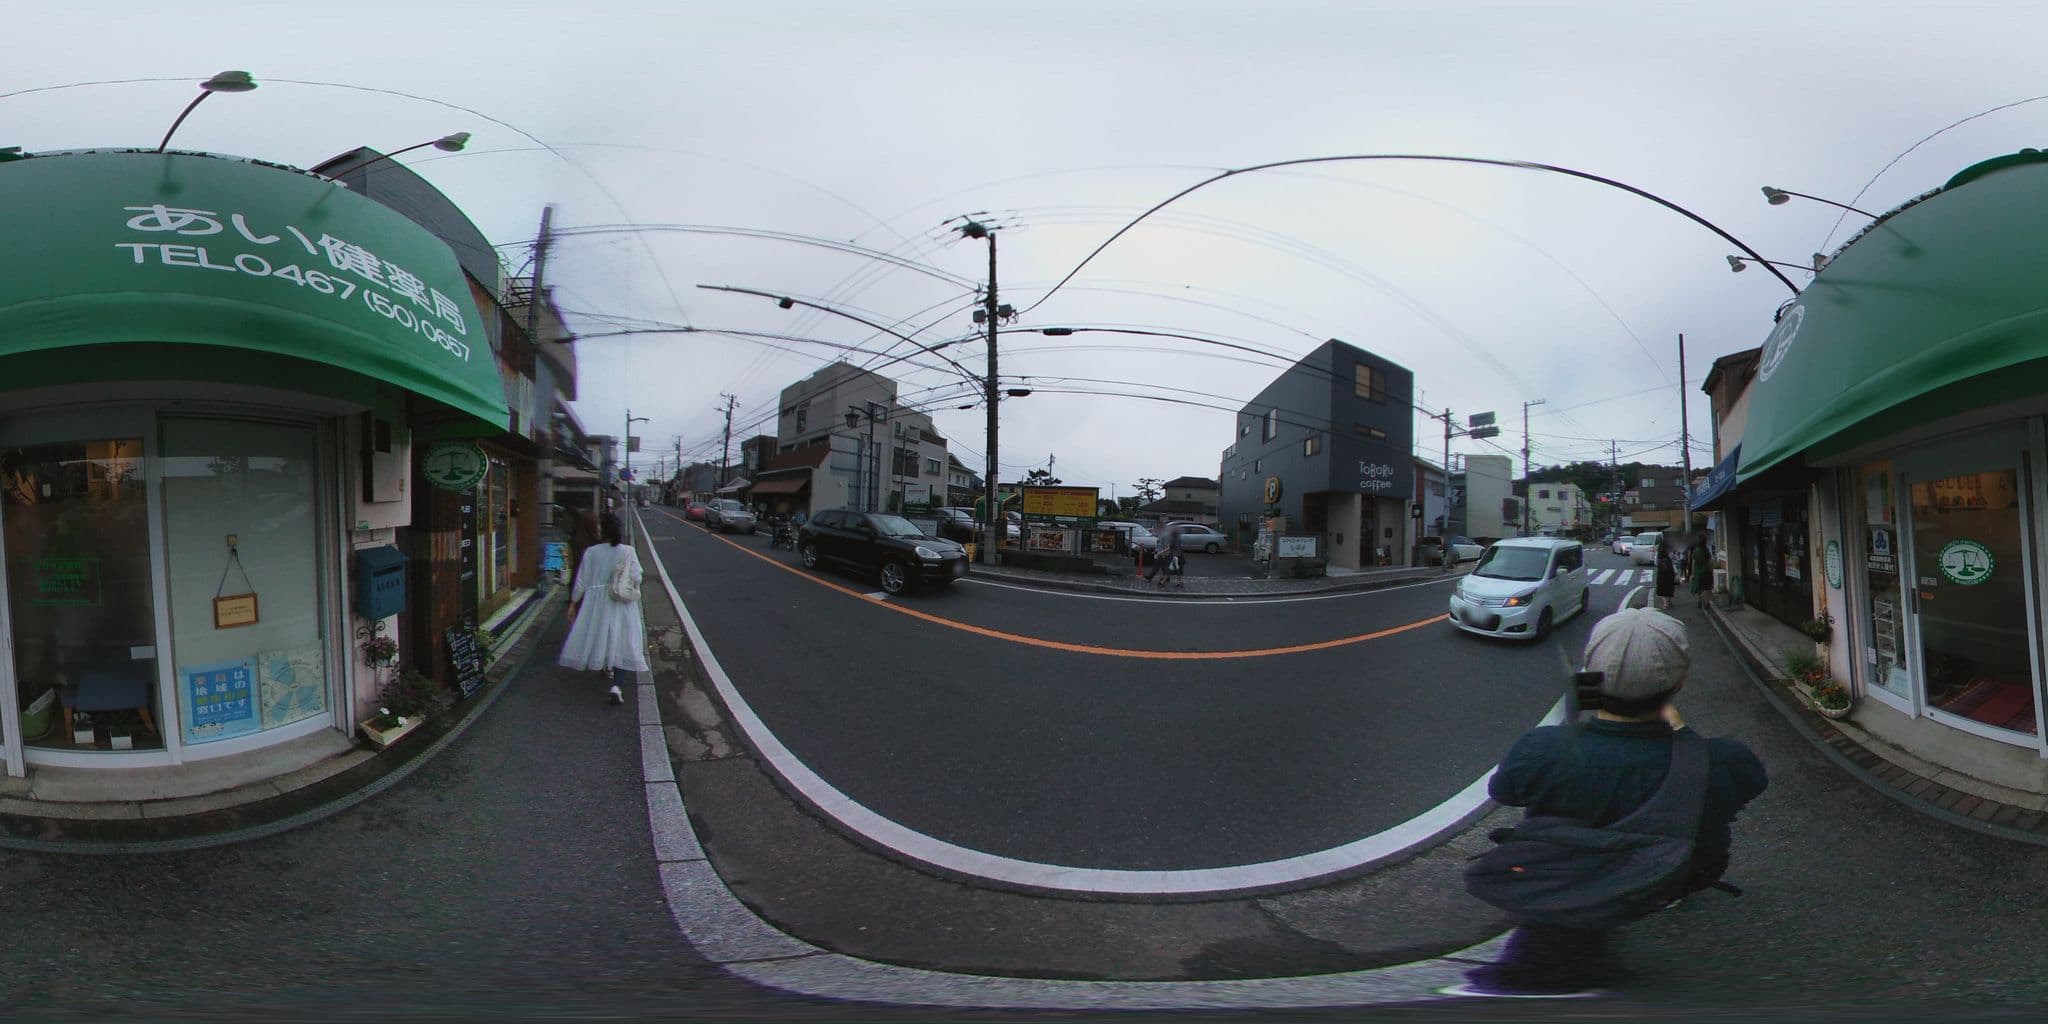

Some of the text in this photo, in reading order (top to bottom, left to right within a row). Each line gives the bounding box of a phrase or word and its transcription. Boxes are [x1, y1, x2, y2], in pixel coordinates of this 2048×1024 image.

[123, 204, 467, 335] あい健薬局
[1269, 482, 1276, 498] P
[1360, 480, 1392, 491] coffee
